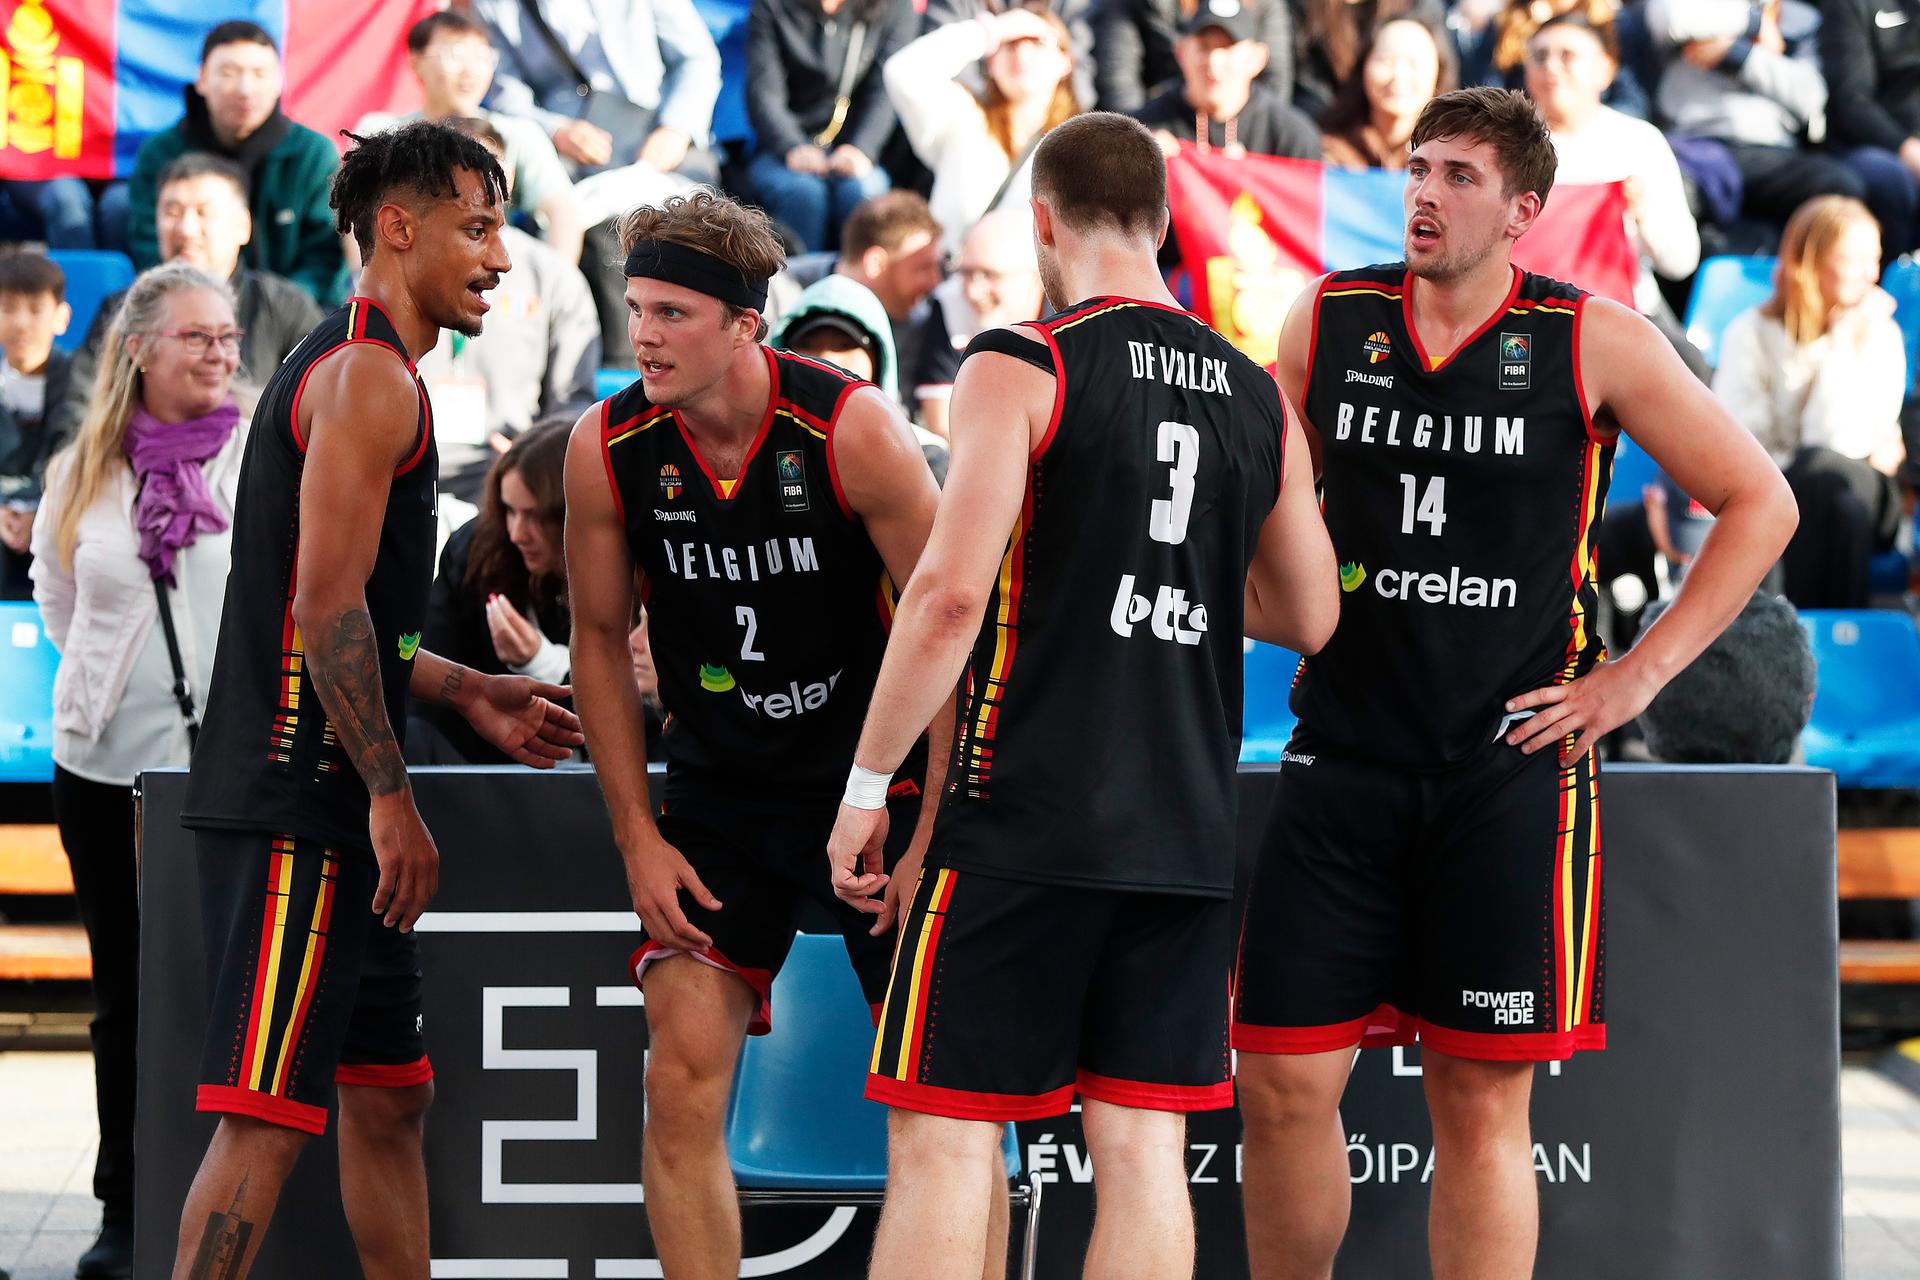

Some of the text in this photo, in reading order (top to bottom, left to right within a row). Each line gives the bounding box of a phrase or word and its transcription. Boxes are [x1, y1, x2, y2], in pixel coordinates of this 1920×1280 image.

[1127, 340, 1233, 397] DE VALCK
[1345, 369, 1394, 389] SPALDING
[1504, 365, 1526, 376] FIBA
[1335, 402, 1525, 456] BELGIUM
[783, 485, 803, 497] FIBA
[1149, 421, 1200, 545] 3
[653, 509, 697, 523] SPALDING
[1400, 473, 1447, 537] 14
[663, 537, 820, 582] BELGIUM
[1374, 566, 1518, 608] crelan
[735, 605, 766, 662] 2
[1462, 989, 1535, 1009] POWER
[1494, 1007, 1535, 1025] ADE
